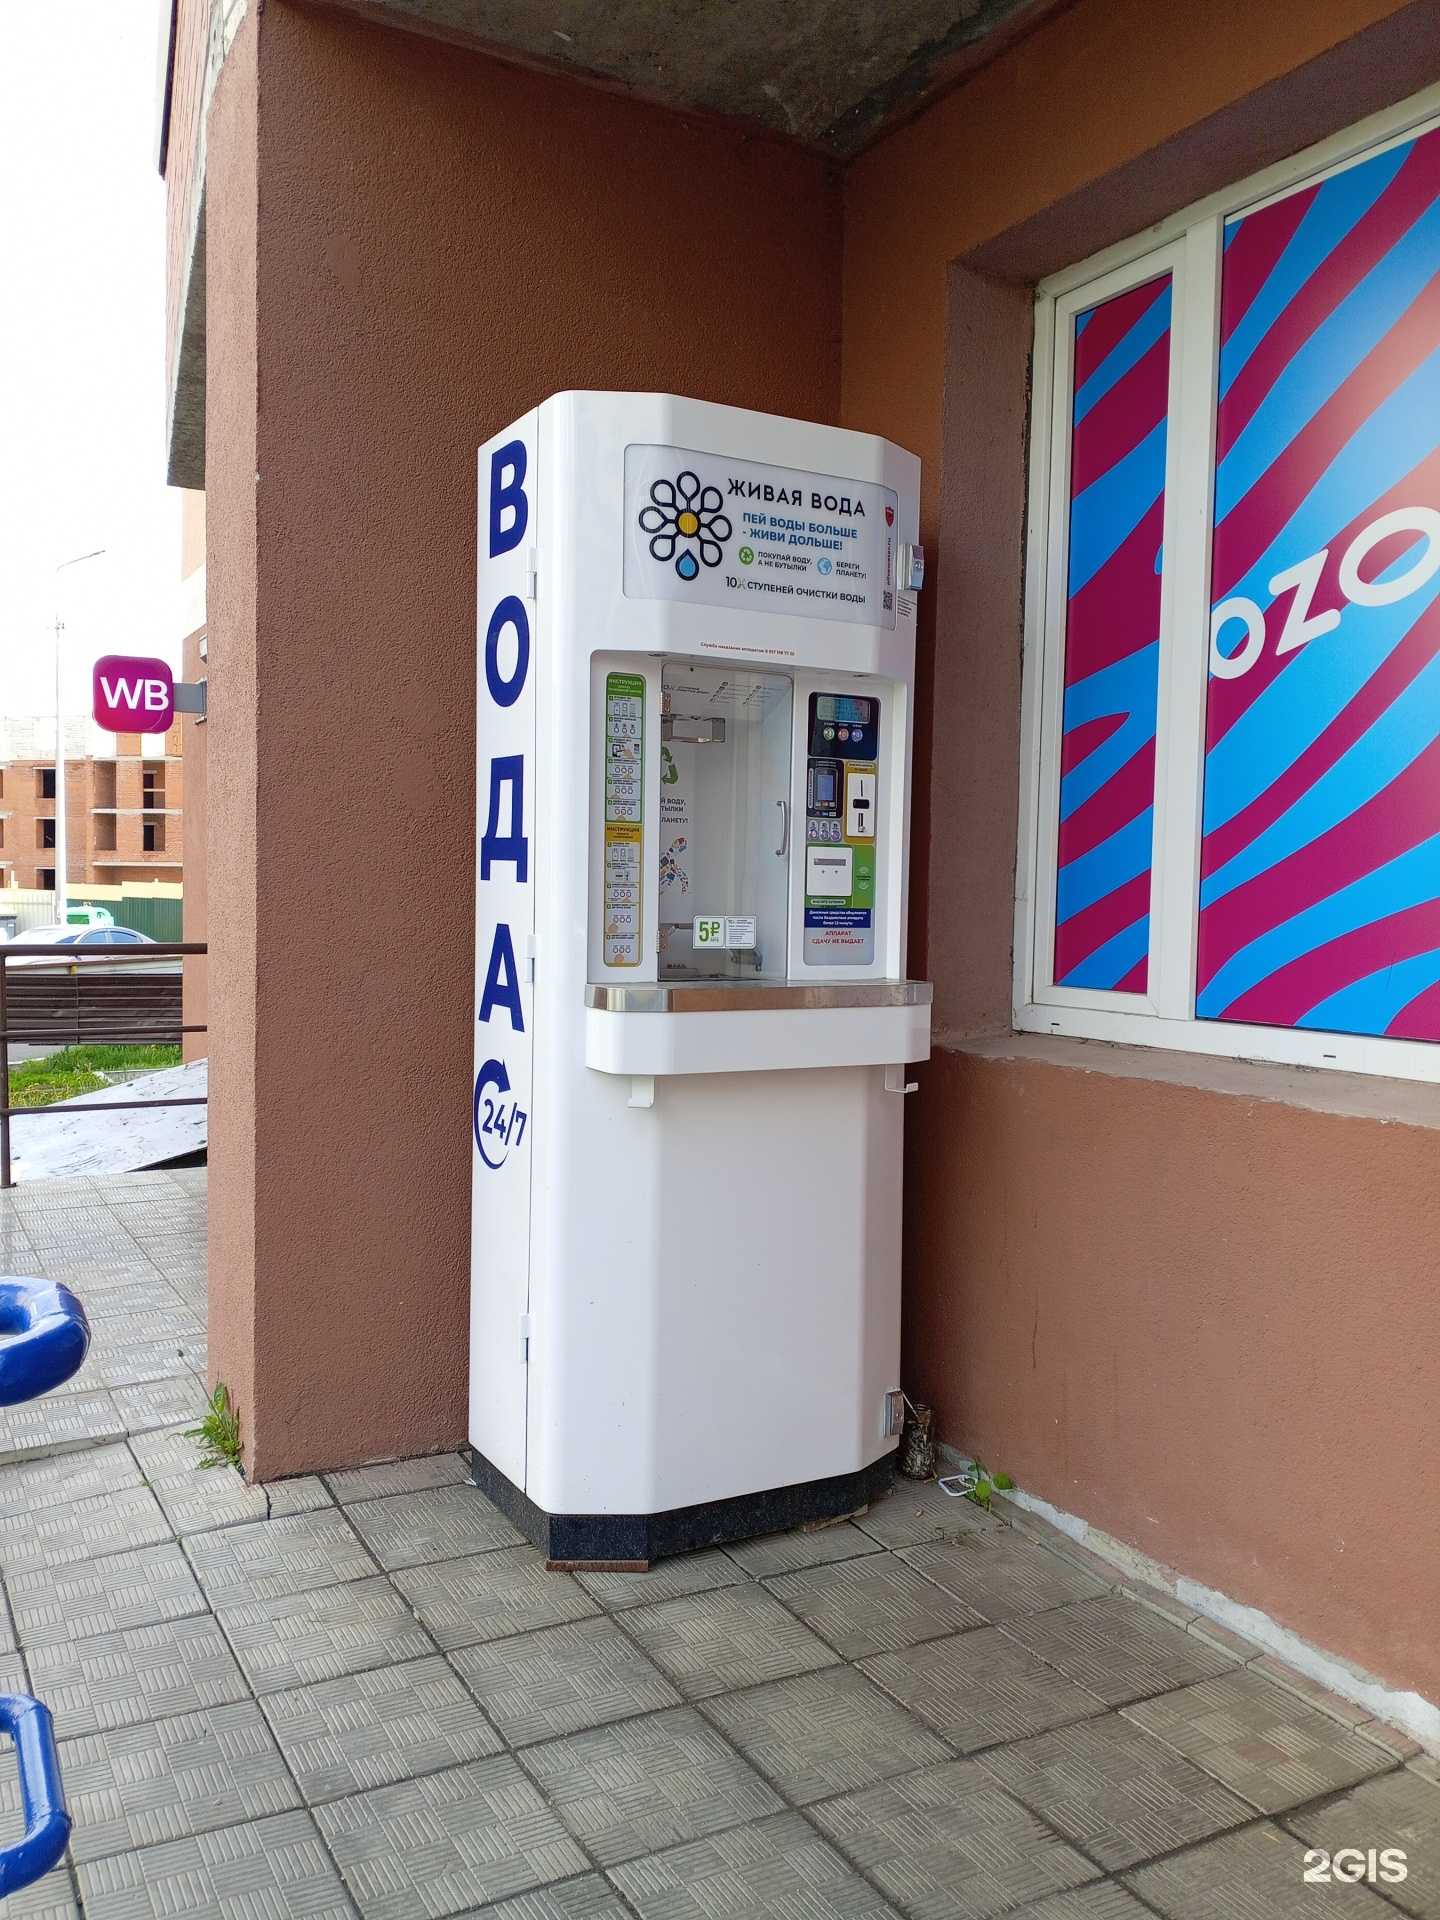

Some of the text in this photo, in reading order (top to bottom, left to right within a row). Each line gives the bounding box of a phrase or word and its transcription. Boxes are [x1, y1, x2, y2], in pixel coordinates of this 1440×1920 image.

[727, 478, 866, 517] ЖИВАЯ ВОДА
[743, 512, 858, 539] ПЕЙ ВОДЫ БОЛЬШЕ
[749, 528, 786, 543] ЖИВИ
[788, 534, 843, 551] ДОЛЬШЕ!
[757, 551, 813, 566] ПОКУПАЙ ВОДУ,
[774, 562, 808, 573] БУТЫЛКИ
[835, 561, 868, 580] БЕРЕГИ ПЛАНЕТУ!
[747, 581, 794, 596] СТУПЕНЕЙ
[796, 587, 839, 601] ОЧИСТКИ
[839, 593, 867, 604] ВОДЫ
[1209, 506, 1440, 680] OZO
[100, 676, 170, 712] WB
[479, 440, 530, 1033] ВОДА
[482, 1098, 527, 1147] 24/7
